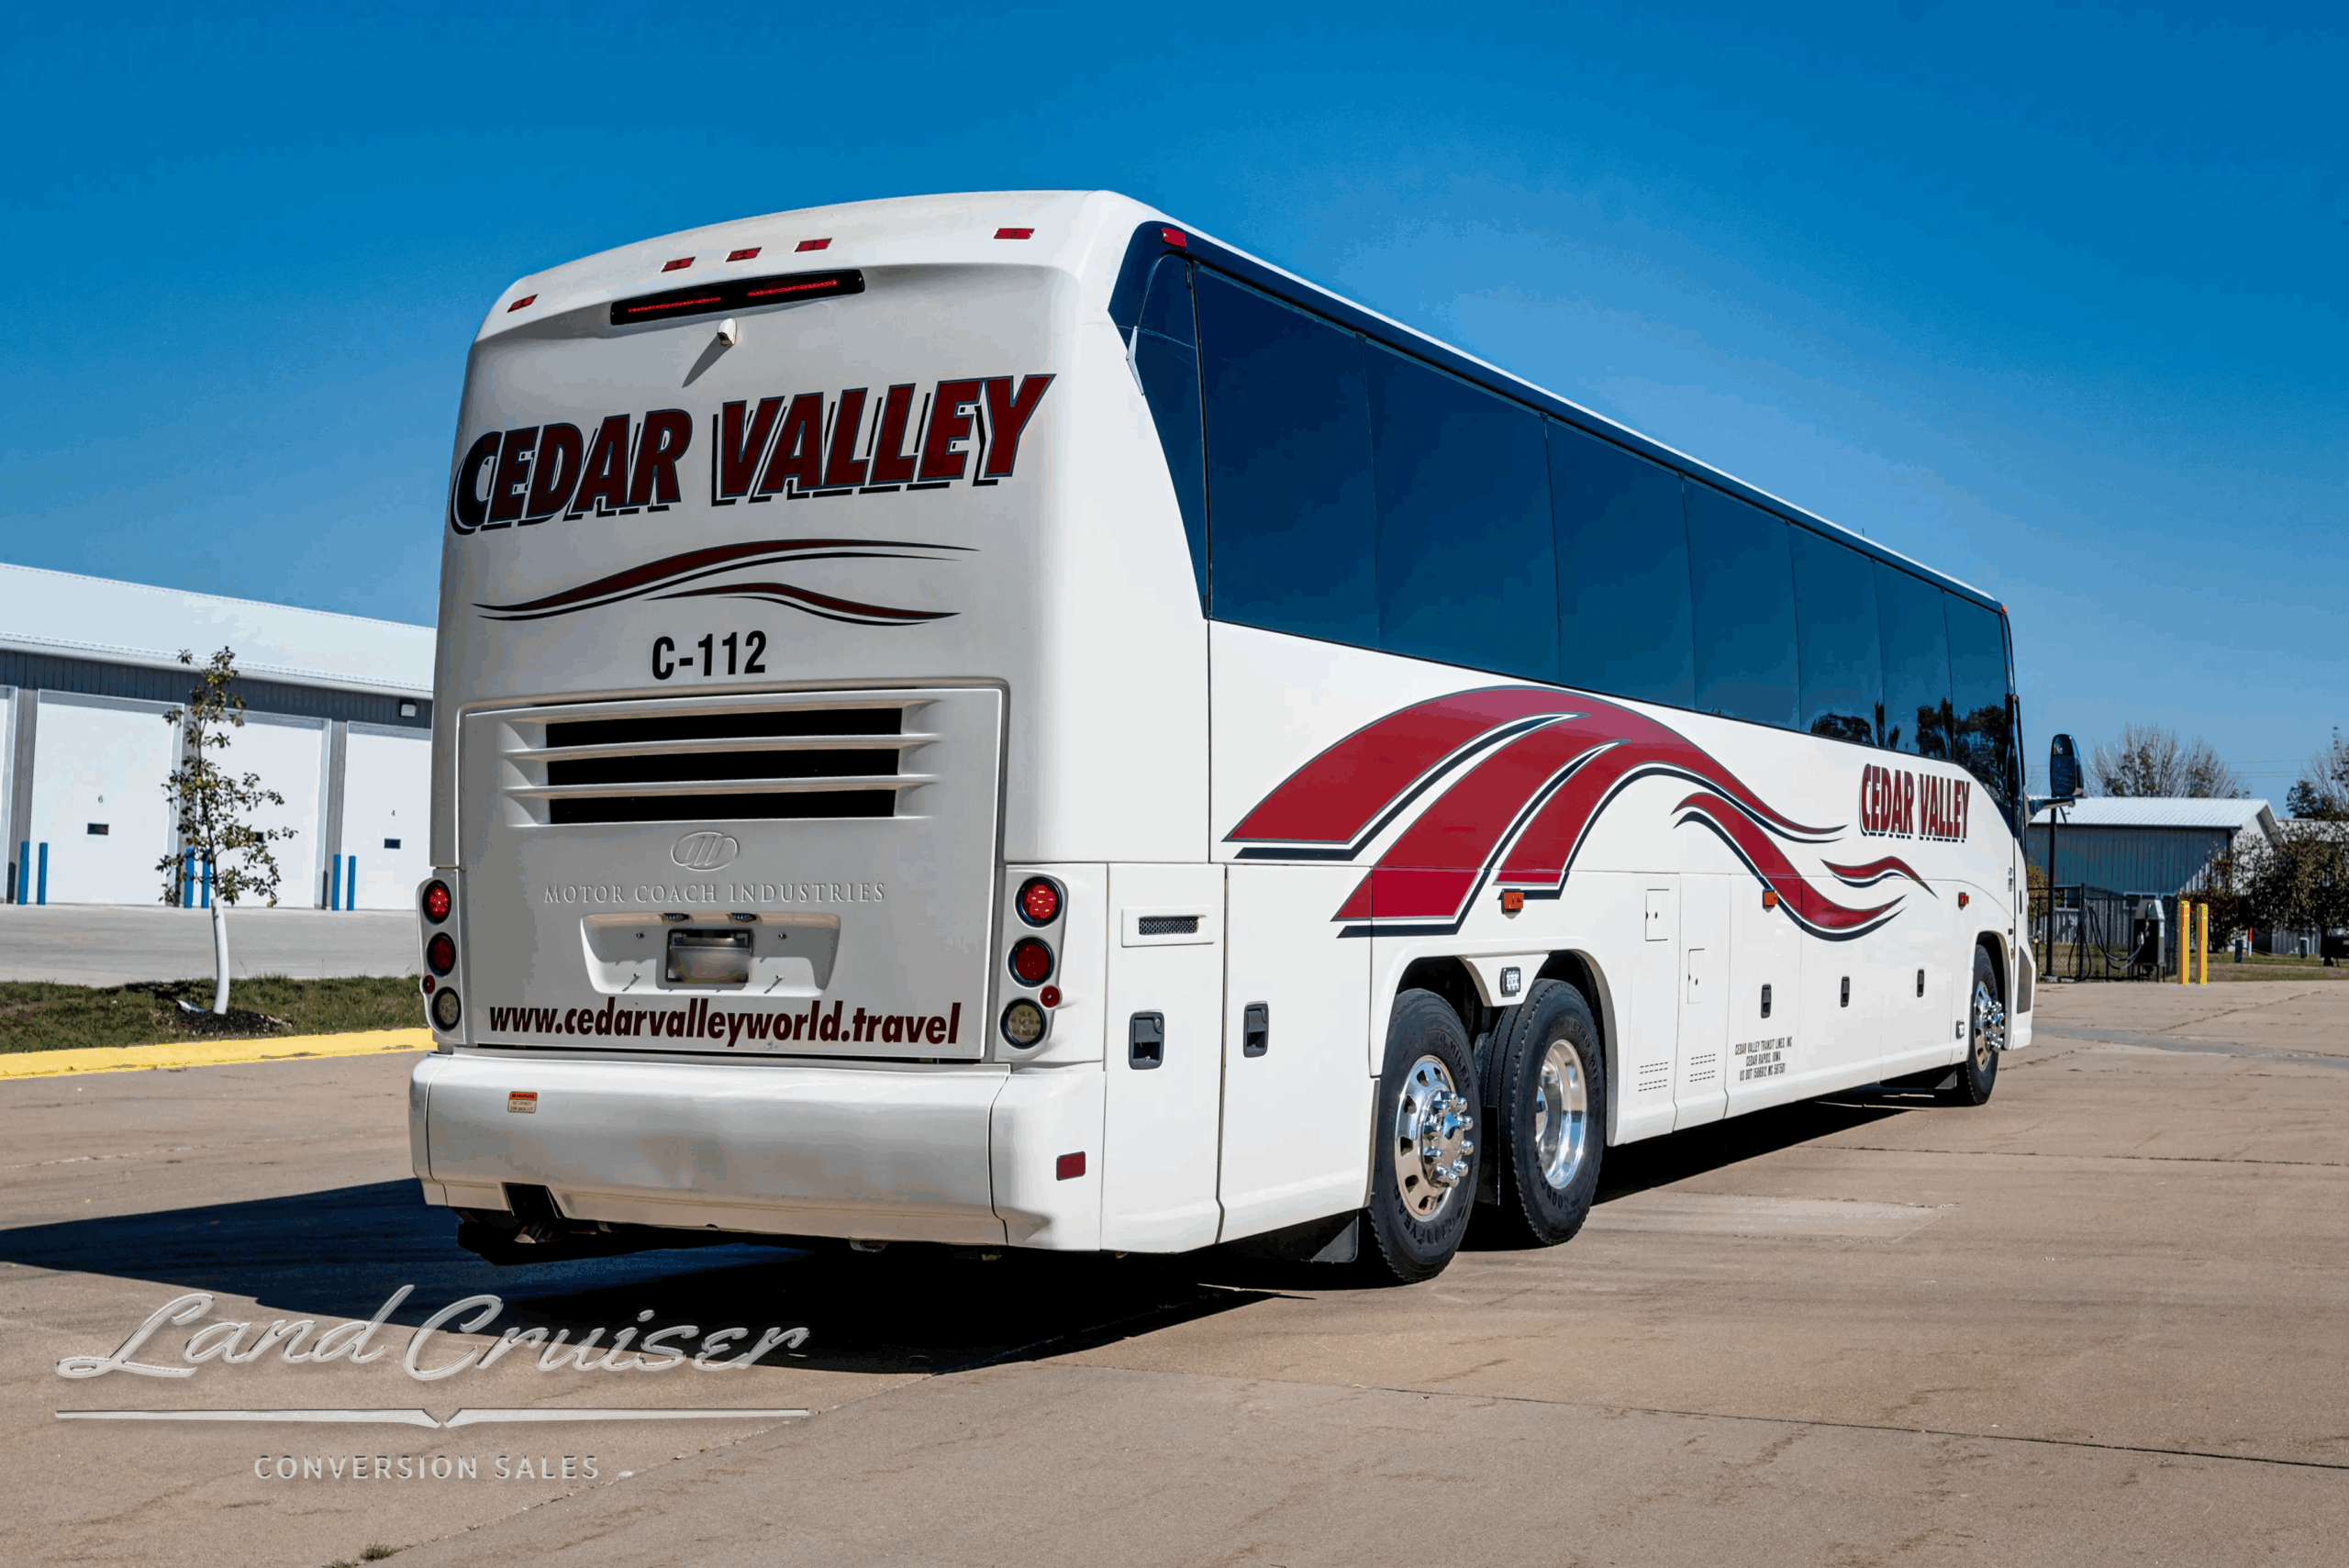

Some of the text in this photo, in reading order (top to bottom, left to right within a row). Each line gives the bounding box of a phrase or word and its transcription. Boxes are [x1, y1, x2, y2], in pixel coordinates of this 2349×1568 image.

[450, 373, 1057, 535] CEDAR VALLEY
[651, 630, 767, 680] C-112
[1859, 763, 1971, 843] CEDAR VALLEY
[544, 882, 885, 904] MOTOR COACH INDUSTRIES
[488, 996, 962, 1047] www.cedarvalleyworld.travel
